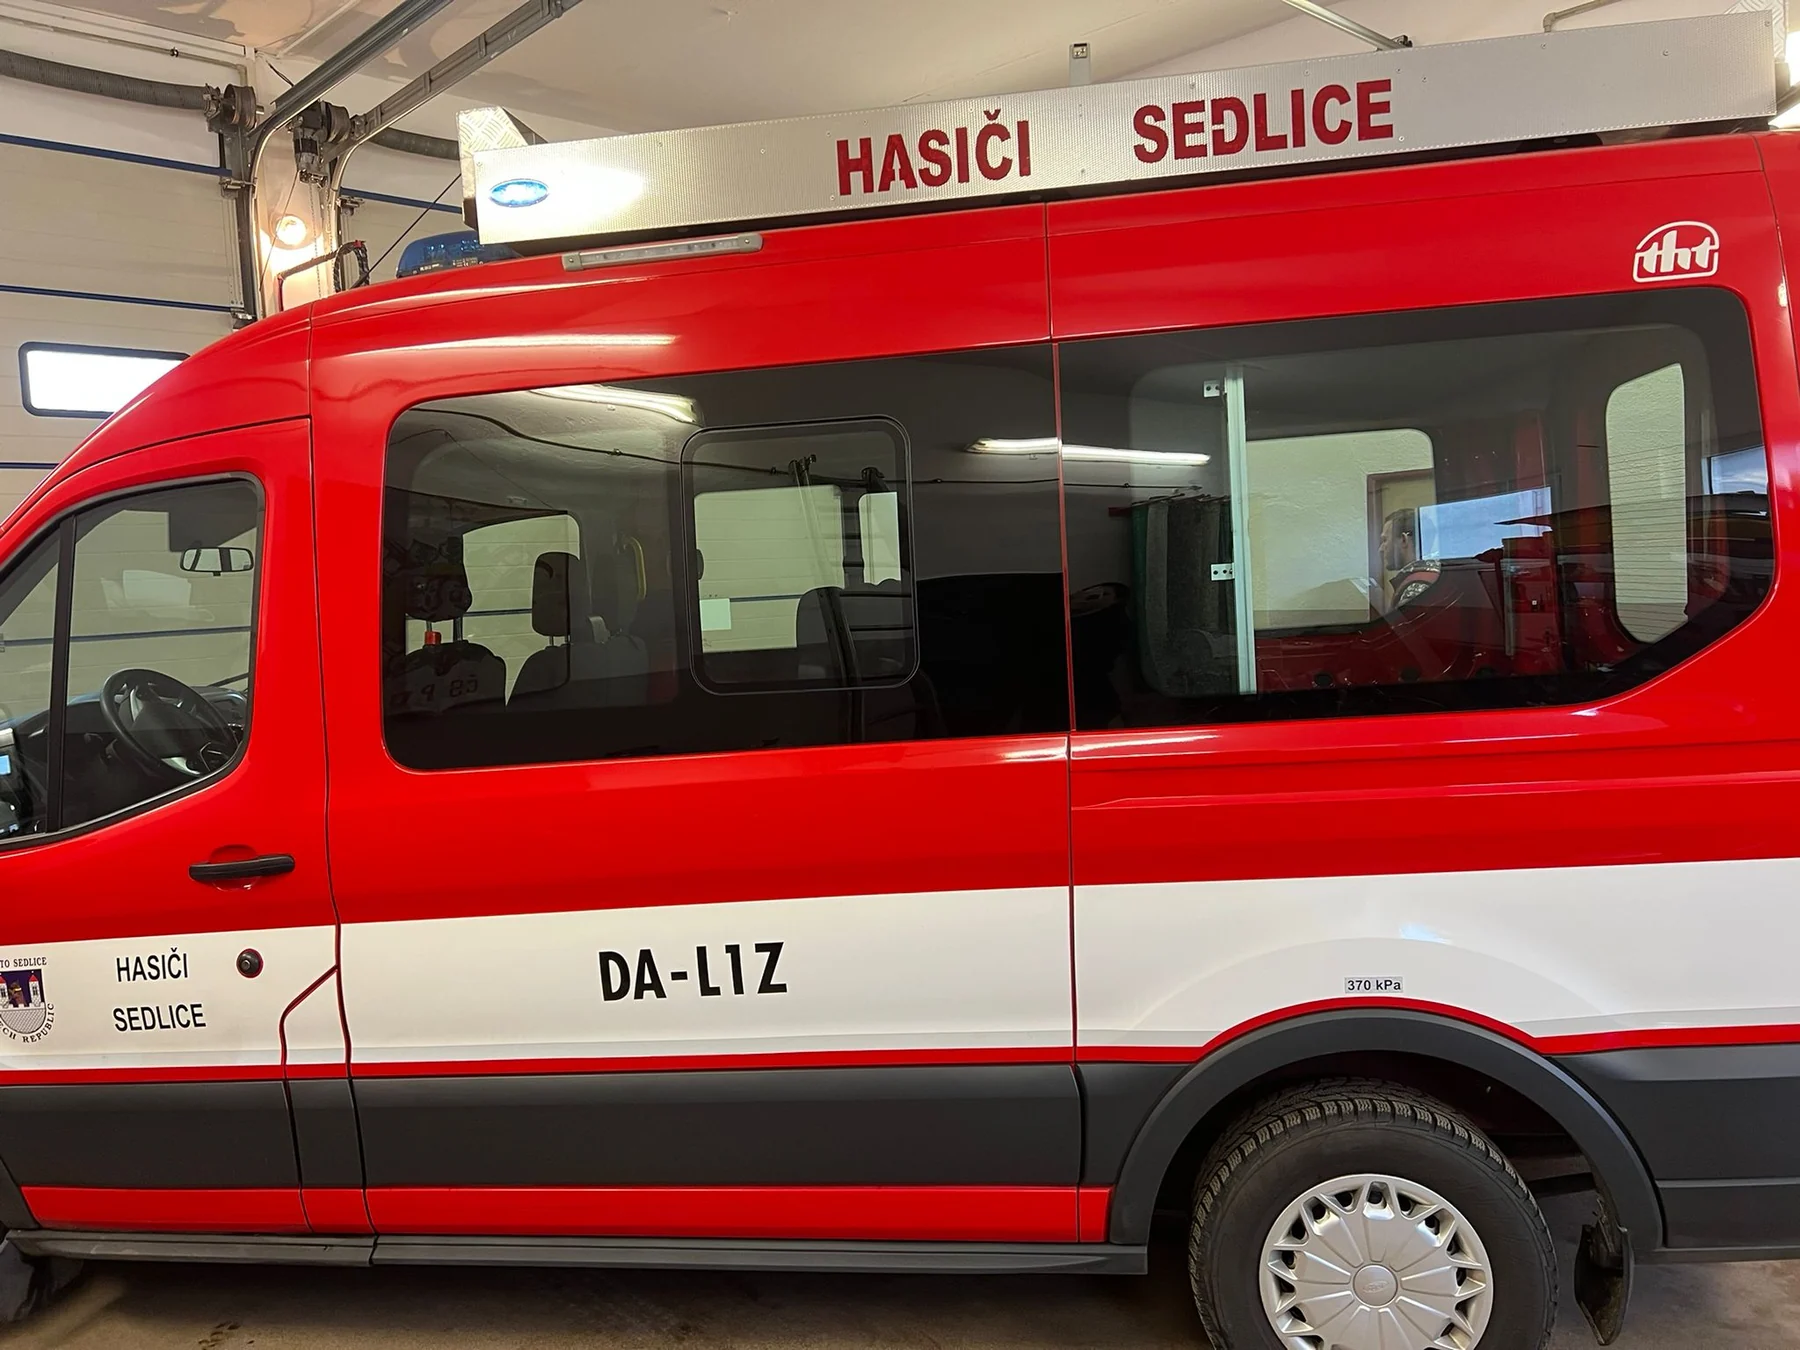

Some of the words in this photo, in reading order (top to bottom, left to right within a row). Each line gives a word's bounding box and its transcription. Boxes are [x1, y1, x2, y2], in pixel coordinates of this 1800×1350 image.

[836, 108, 1032, 196] HASIČI
[1132, 79, 1394, 164] SEDLICE
[13, 956, 47, 967] SEDLICE
[116, 947, 188, 982] HASIČI
[598, 941, 788, 1001] DA-L1Z
[1347, 979, 1371, 991] 370
[1375, 979, 1401, 991] kPa
[23, 1003, 55, 1043] REPUBLIC
[113, 1003, 206, 1032] SEDLICE
